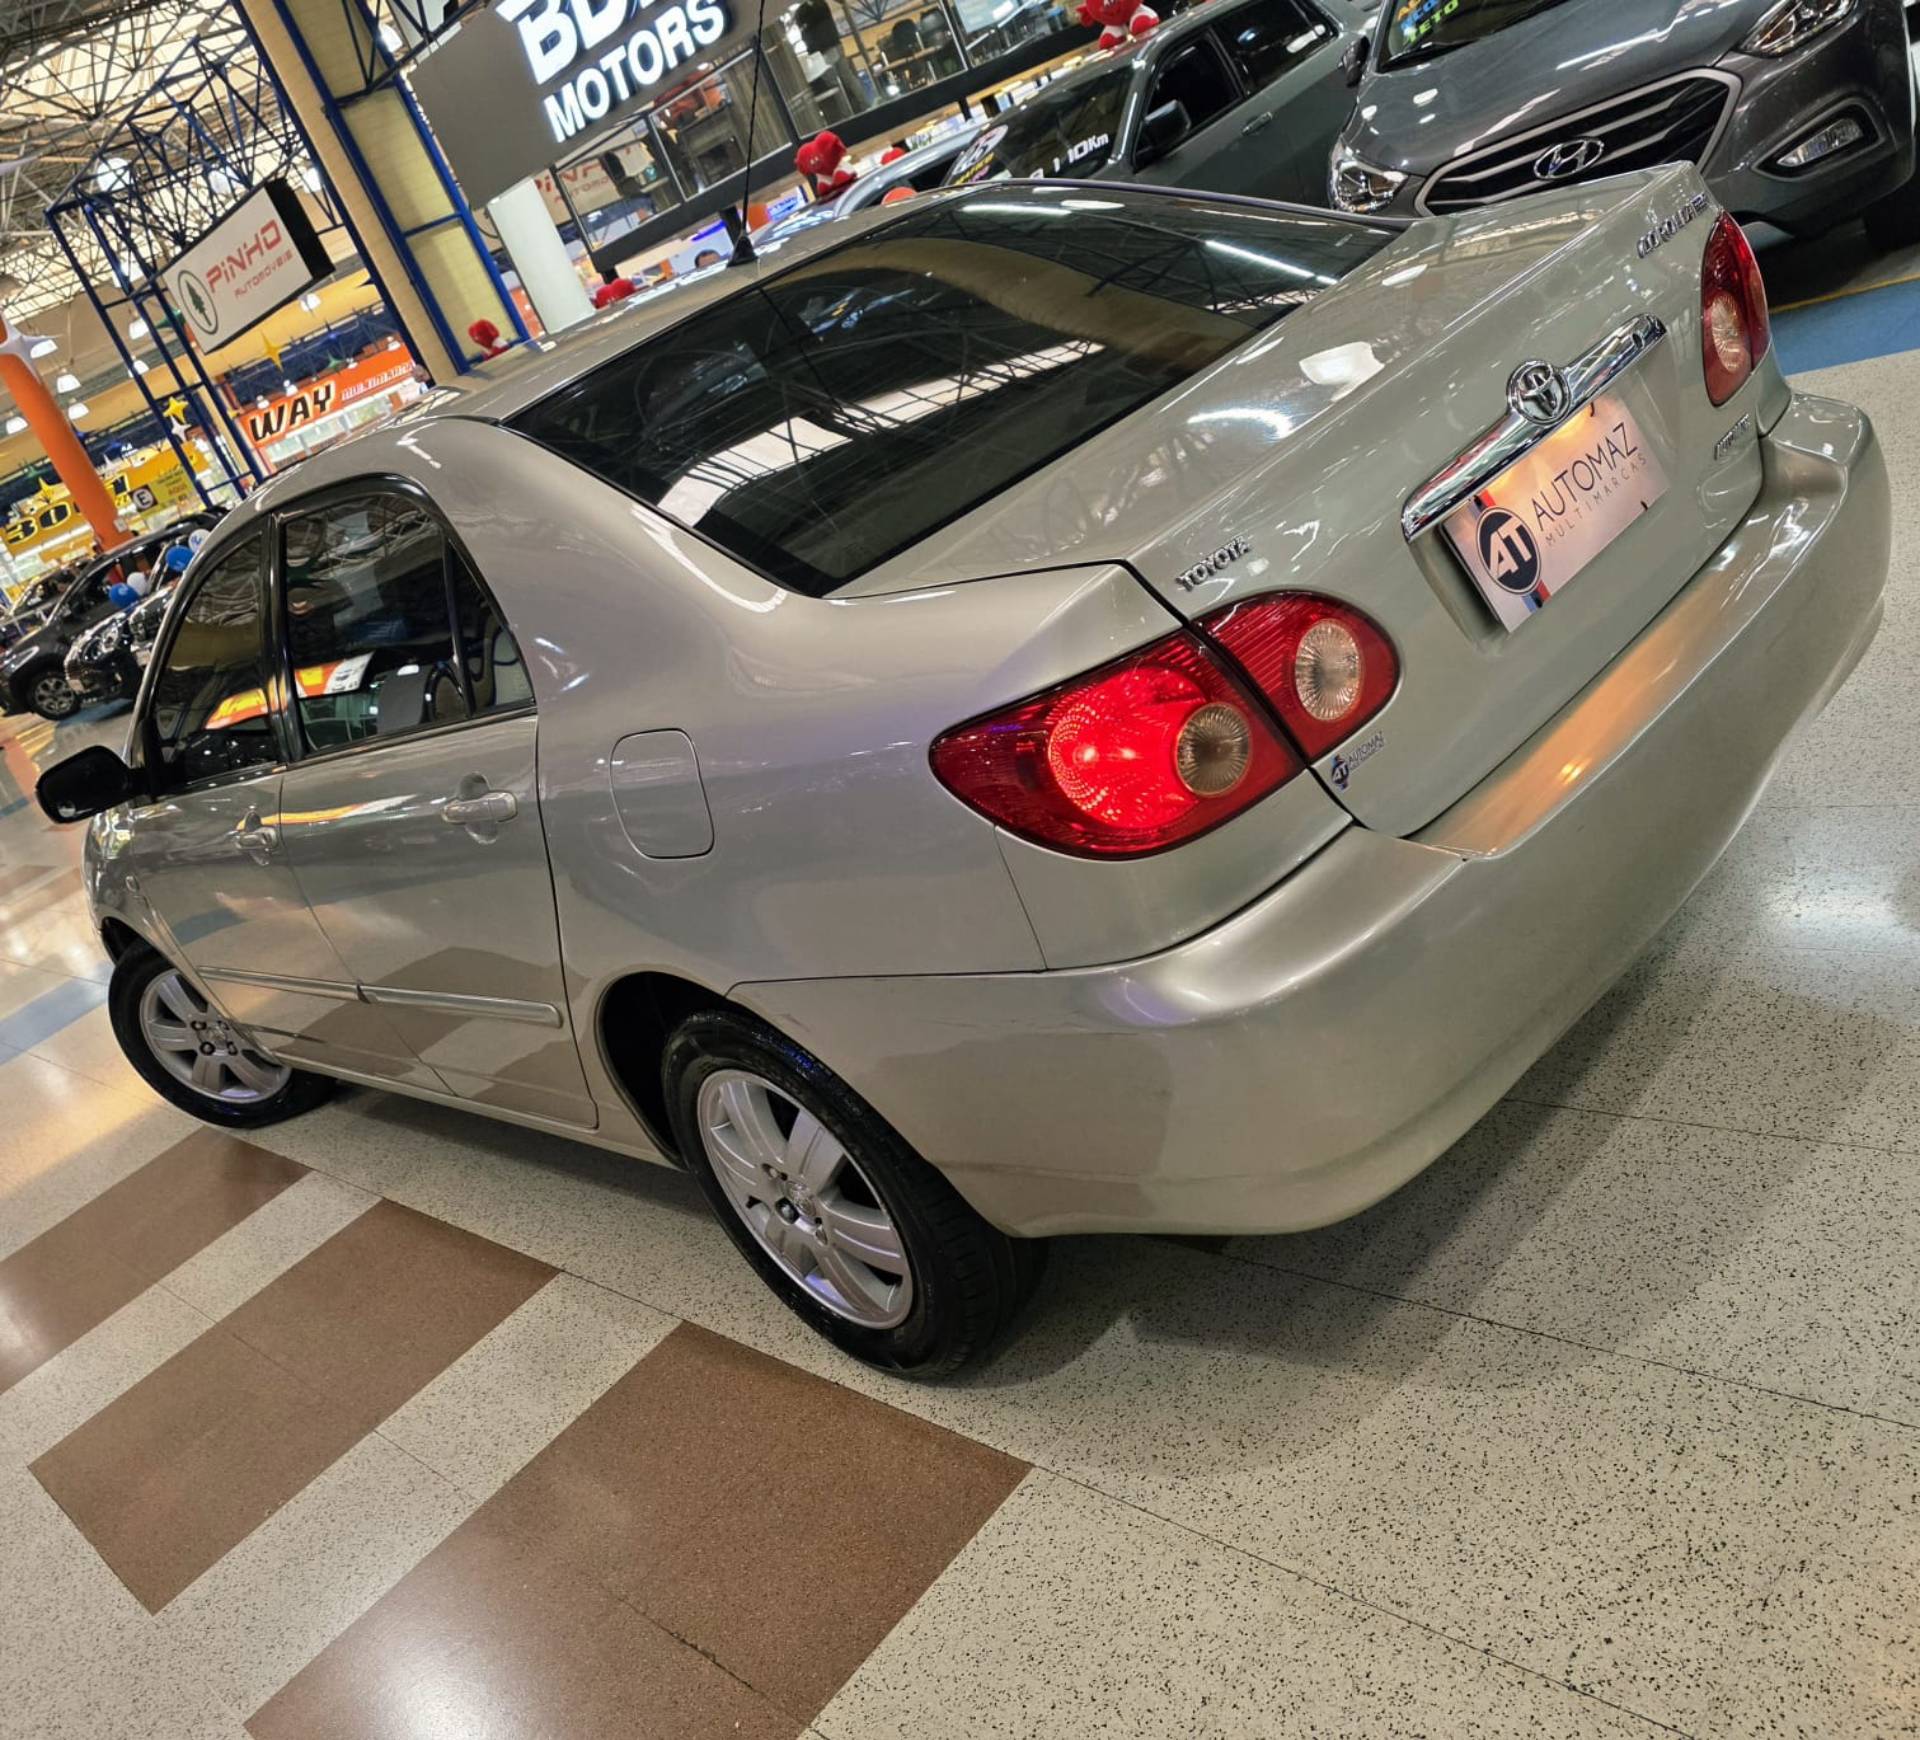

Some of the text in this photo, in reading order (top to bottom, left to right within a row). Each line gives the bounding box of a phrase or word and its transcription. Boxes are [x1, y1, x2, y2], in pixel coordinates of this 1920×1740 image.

[544, 0, 724, 143] MOTORS
[249, 382, 333, 442] WAY
[1531, 421, 1638, 532] AUTOMAZ
[1545, 454, 1647, 543] MULTIMARCAS
[1175, 536, 1250, 592] TOYOTA
